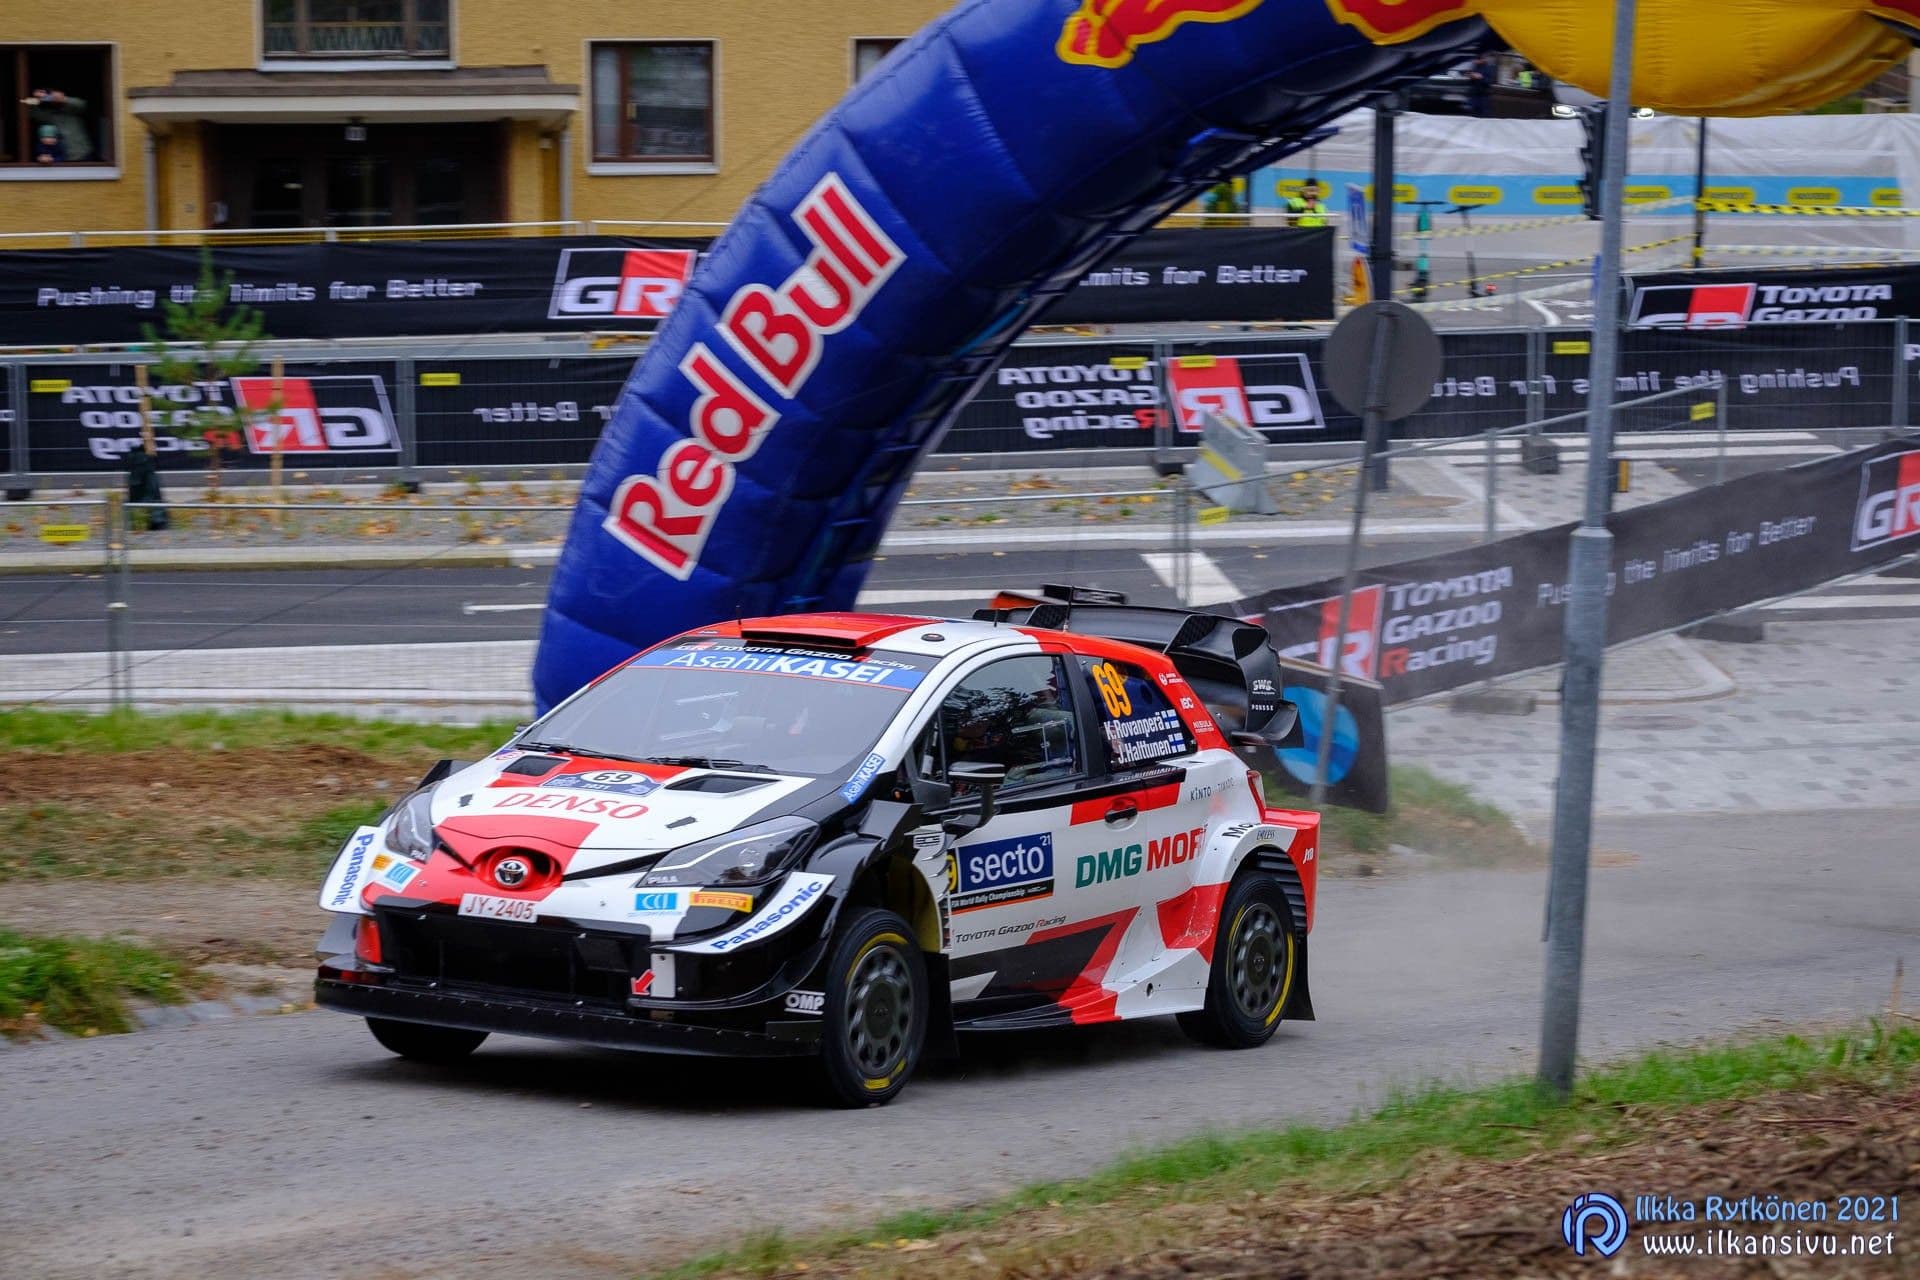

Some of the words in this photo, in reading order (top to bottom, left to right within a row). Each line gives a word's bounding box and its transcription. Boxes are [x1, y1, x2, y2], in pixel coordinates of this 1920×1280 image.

[1080, 268, 1149, 286] mits
[1162, 267, 1206, 284] for
[1216, 265, 1307, 284] Better
[36, 287, 156, 309] Pushing
[229, 283, 316, 302] limits
[329, 281, 376, 299] for
[386, 279, 483, 298] Better
[559, 277, 684, 313] GR
[1758, 285, 1893, 304] TOYOTA
[602, 342, 781, 580] Red
[714, 171, 908, 399] Bull
[1386, 566, 1513, 611] TOYOTA
[1382, 601, 1502, 645] GAZOO
[714, 645, 782, 653] TOYOTA
[785, 648, 851, 660] GAZOO
[1380, 634, 1498, 678] Racing
[1092, 663, 1132, 718] 69
[593, 772, 632, 782] 69
[493, 793, 649, 819] DENSO
[331, 833, 375, 906] Panasonic
[969, 843, 1045, 884] secto
[1075, 844, 1142, 889] DMG
[466, 899, 535, 920] JY-2405
[710, 881, 824, 950] Panasonic
[955, 929, 995, 943] TOYOTA
[997, 923, 1034, 935] GAZOO
[1036, 915, 1066, 929] Racing
[786, 993, 824, 1010] OMP
